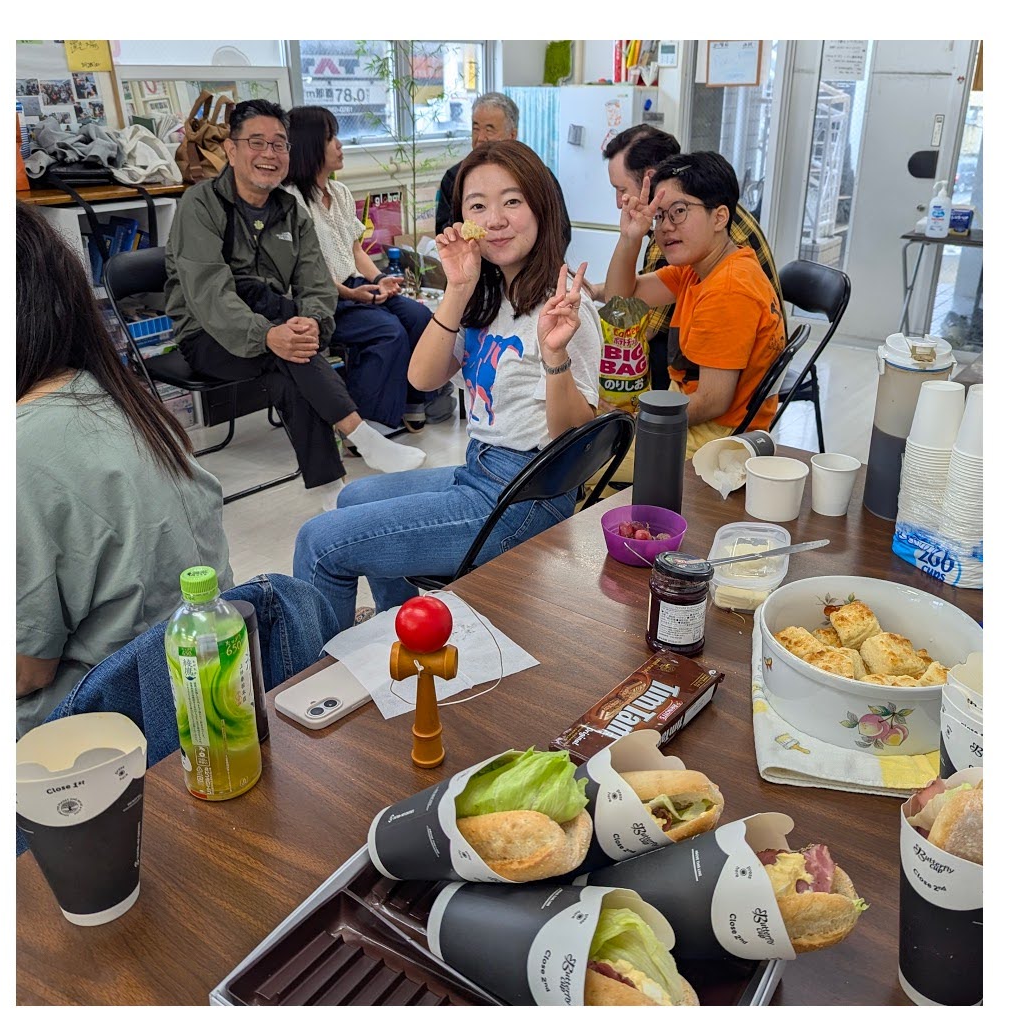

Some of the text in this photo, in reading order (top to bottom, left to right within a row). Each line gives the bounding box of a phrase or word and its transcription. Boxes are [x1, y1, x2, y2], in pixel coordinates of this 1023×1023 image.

[604, 342, 644, 362] BIG
[599, 356, 647, 377] BAG
[604, 379, 645, 391] のりしお
[226, 641, 242, 656] 650
[46, 780, 86, 795] Close 1st
[613, 833, 625, 851] Close
[913, 843, 955, 874] Butterfly
[913, 868, 947, 892] Close 2nd
[729, 913, 748, 944] Close 2nd
[752, 907, 775, 946] Butterfly
[541, 949, 552, 992] Close 2nd
